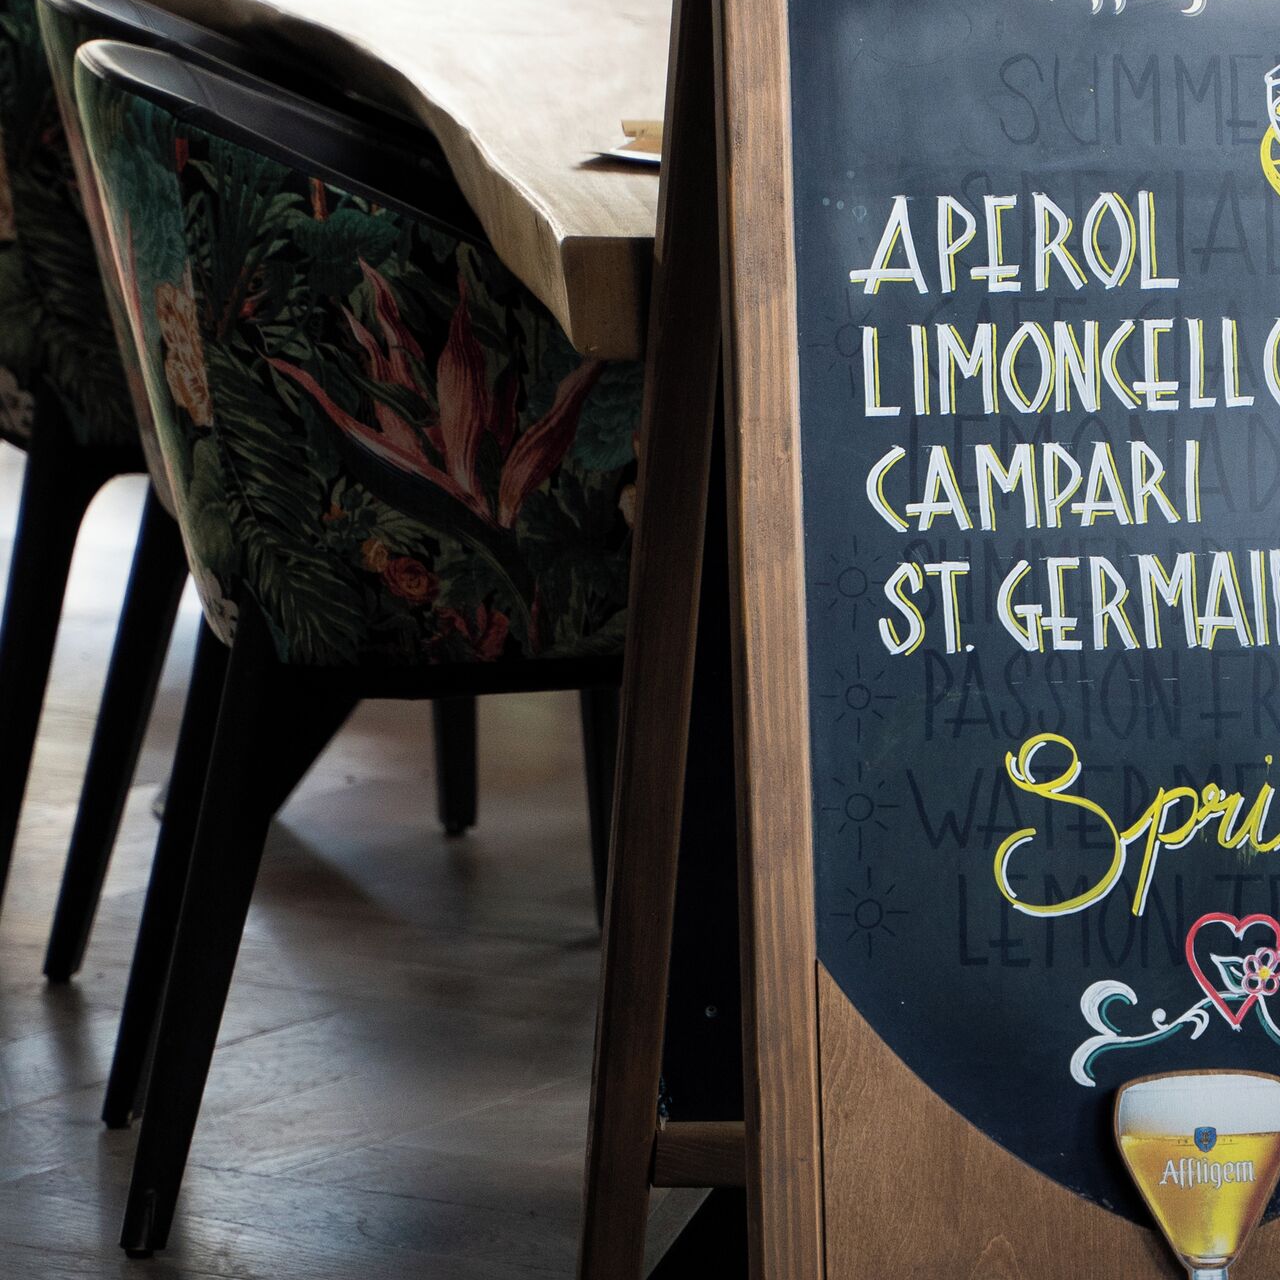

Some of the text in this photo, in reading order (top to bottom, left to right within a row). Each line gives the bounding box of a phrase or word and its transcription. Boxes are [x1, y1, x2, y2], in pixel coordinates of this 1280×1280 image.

[850, 191, 1181, 296] APEROL
[865, 438, 1203, 533] CAMPARI
[878, 558, 976, 656] ST.
[1159, 1157, 1256, 1189] Affligem
